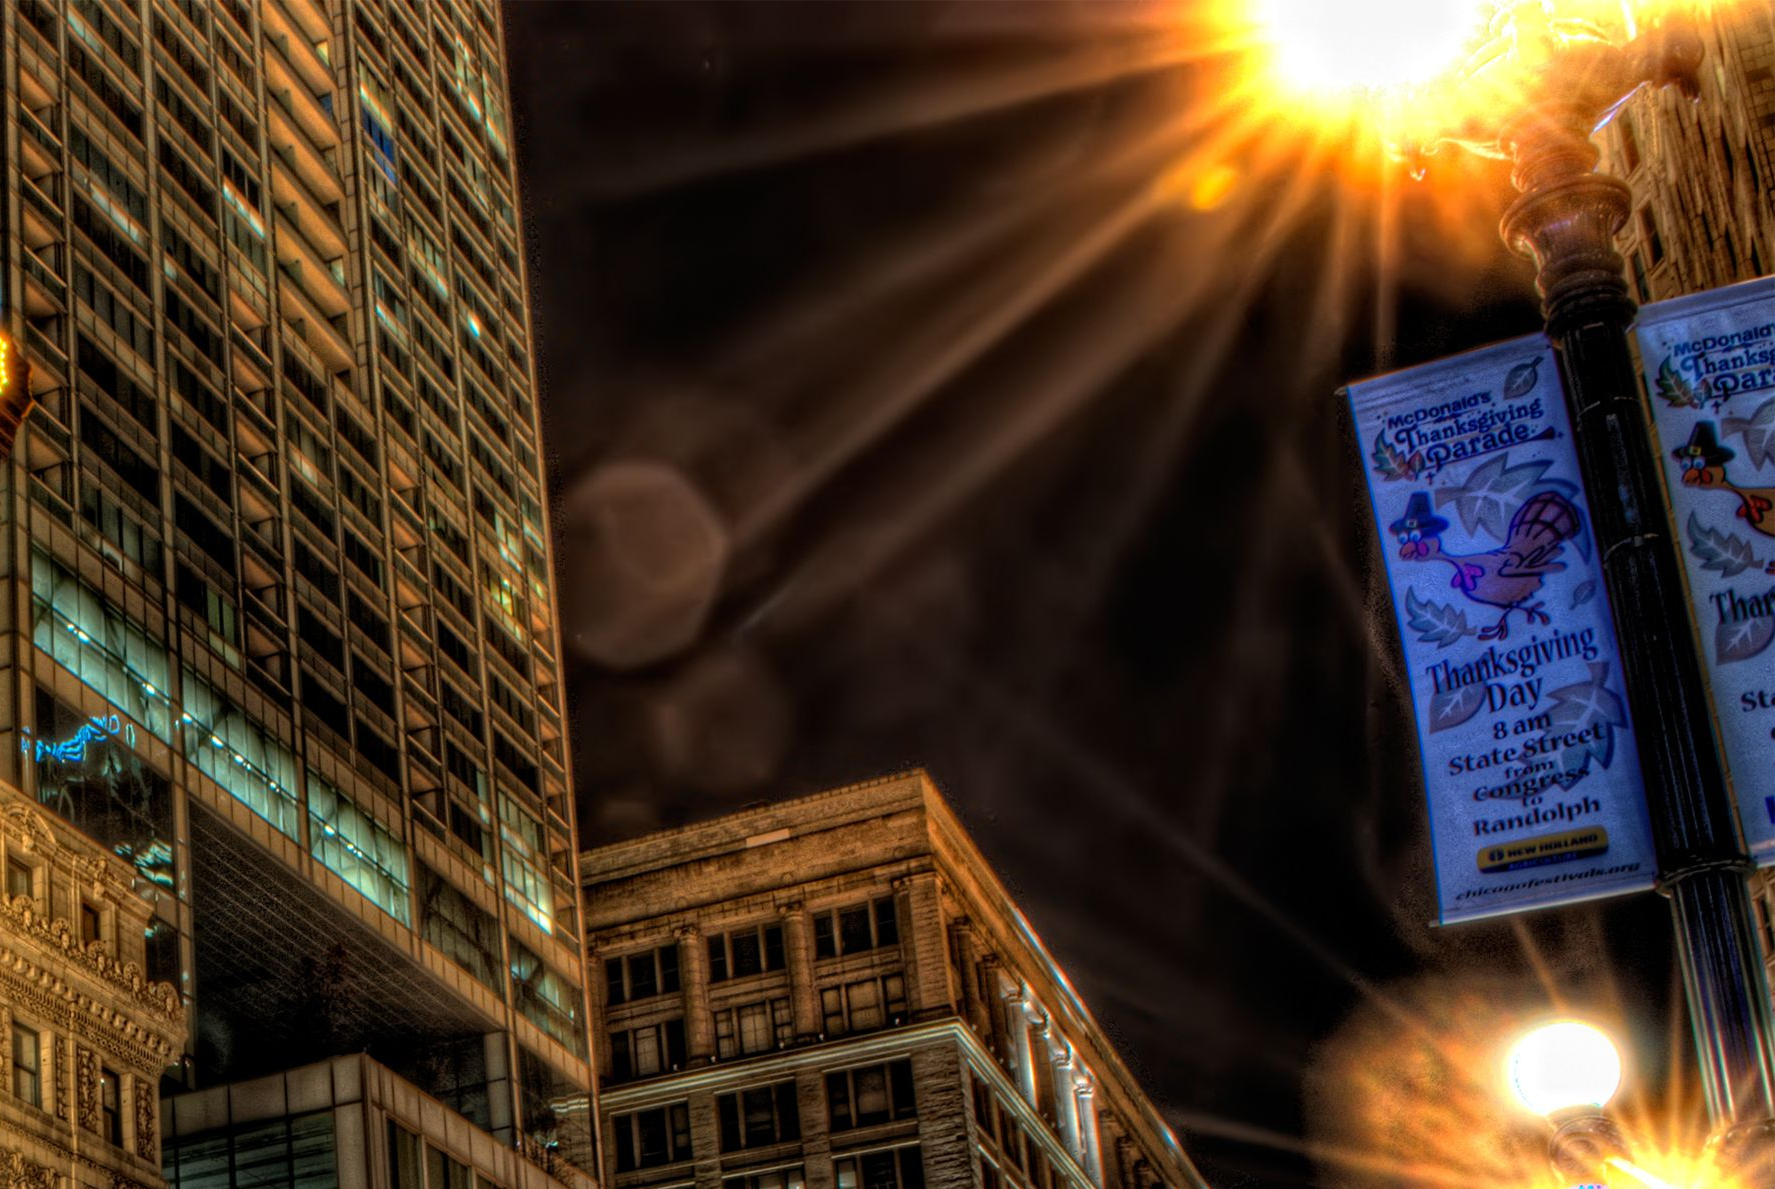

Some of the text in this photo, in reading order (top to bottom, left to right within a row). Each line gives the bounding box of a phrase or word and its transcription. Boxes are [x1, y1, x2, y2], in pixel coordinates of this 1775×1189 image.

[1674, 322, 1775, 357] McDonald'
[1387, 390, 1493, 429] McDonald's
[1395, 398, 1544, 454] Thanksgiving
[1426, 422, 1529, 473] Parade
[1426, 628, 1599, 695] Thanksgiving
[1486, 677, 1543, 713] Day
[1493, 713, 1552, 740] 8 am
[1449, 721, 1606, 776] State Street
[1473, 767, 1590, 802] Congress
[1505, 760, 1554, 779] from
[1473, 796, 1601, 836] Randolph
[1523, 797, 1543, 808] to
[1456, 862, 1641, 900] chicagofestivals.org
